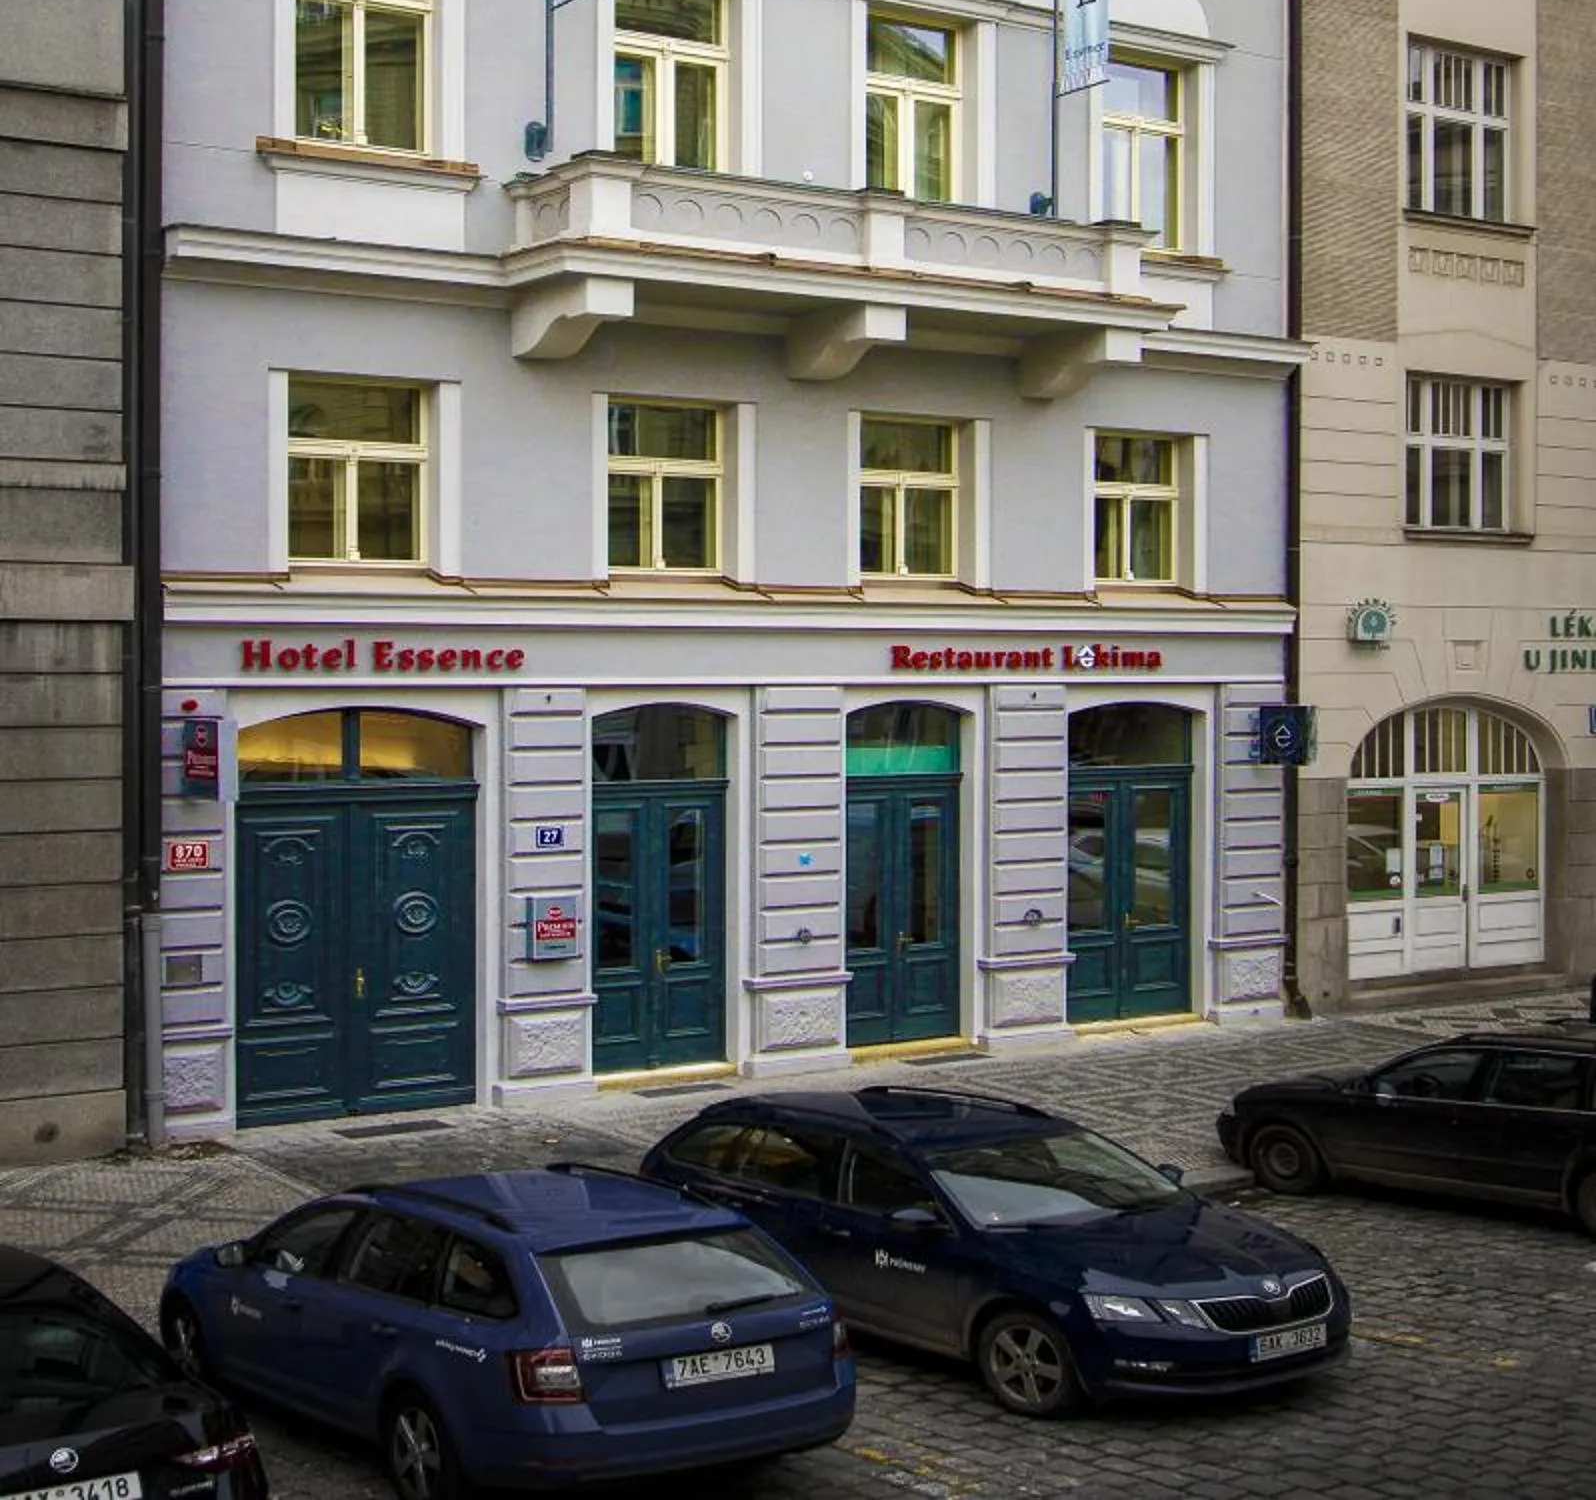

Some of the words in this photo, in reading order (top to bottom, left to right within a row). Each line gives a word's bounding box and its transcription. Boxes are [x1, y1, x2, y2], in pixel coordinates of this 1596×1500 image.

[1550, 608, 1596, 638] LÉK
[240, 639, 356, 671] Hotel
[372, 641, 525, 671] Essence
[890, 645, 1054, 670] Restaurant
[1525, 649, 1540, 670] U
[543, 830, 558, 843] 27
[175, 845, 203, 859] 870
[677, 1357, 710, 1377] 7AE
[723, 1348, 766, 1371] 7643
[71, 1478, 129, 1500] 3418
